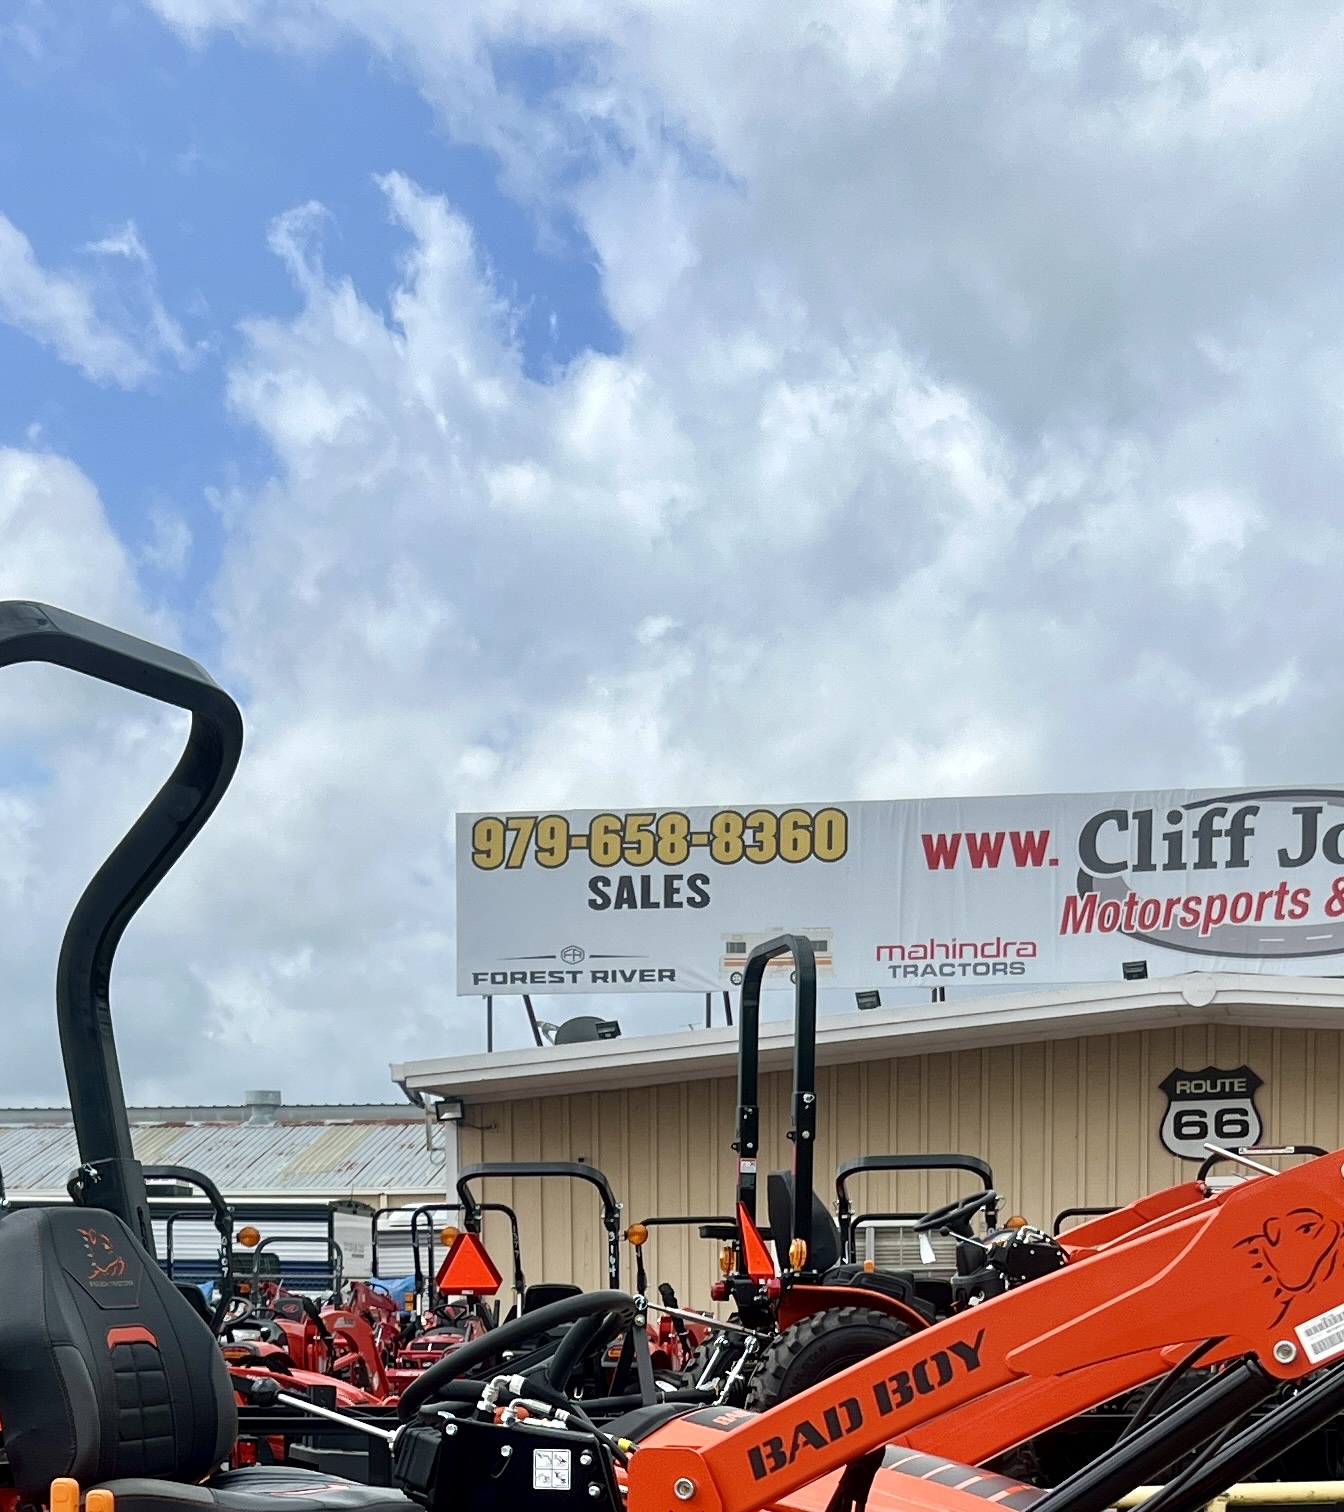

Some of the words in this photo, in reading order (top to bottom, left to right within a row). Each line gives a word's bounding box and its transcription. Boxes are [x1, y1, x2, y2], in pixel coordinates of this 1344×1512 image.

[471, 808, 848, 870] 979-658-8360
[1077, 805, 1260, 876] Cliff
[588, 873, 711, 911] SALES
[1059, 878, 1311, 937] Motorsports
[876, 936, 1038, 962] mahindra
[472, 970, 584, 986] FOREST
[589, 968, 677, 984] RIVER
[888, 960, 1027, 979] TRACTORS
[1175, 1077, 1247, 1095] ROUTE
[1173, 1107, 1250, 1140] 66
[747, 1396, 864, 1481] BAD
[872, 1328, 986, 1417] BOY
